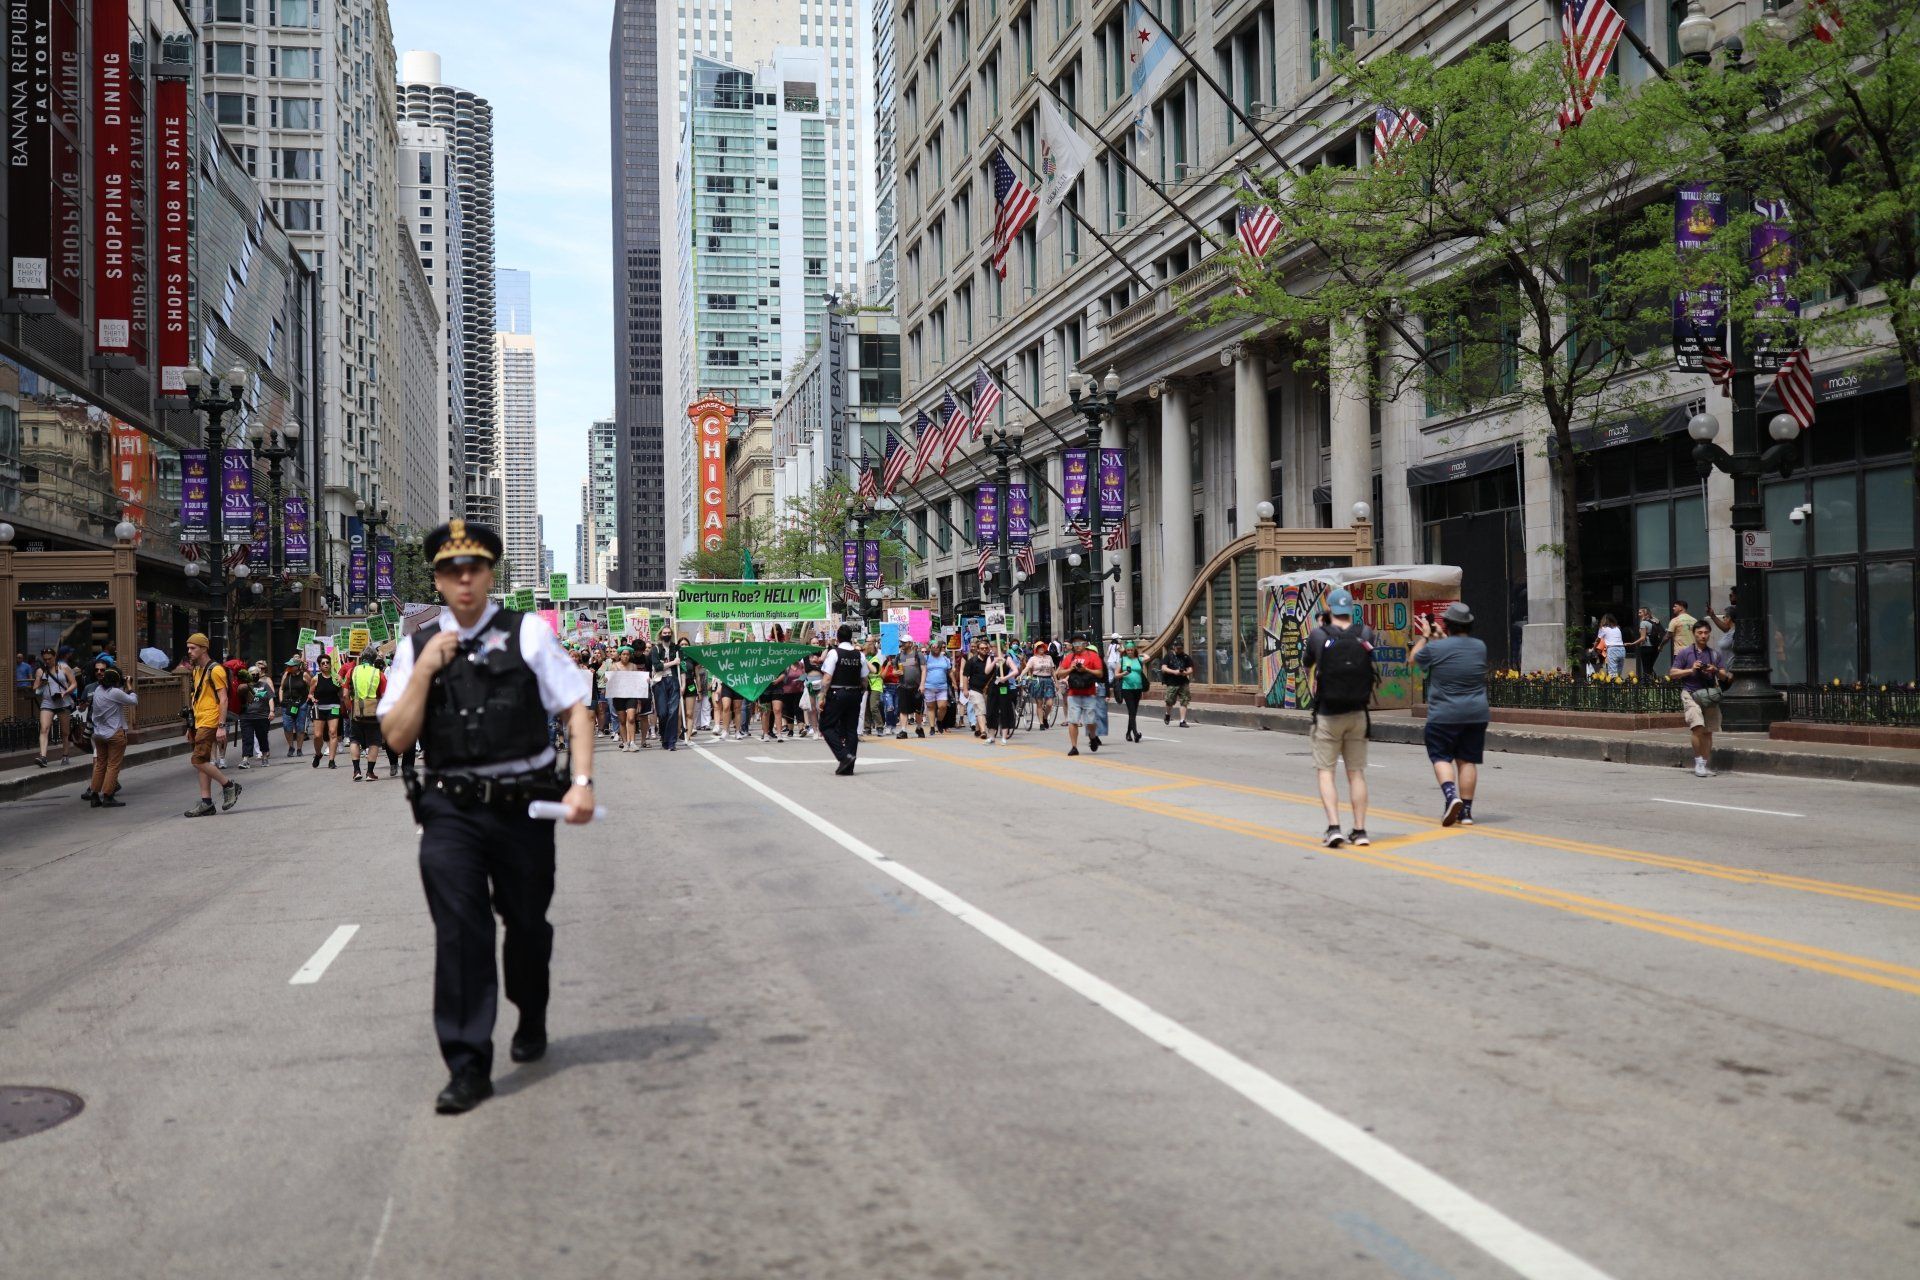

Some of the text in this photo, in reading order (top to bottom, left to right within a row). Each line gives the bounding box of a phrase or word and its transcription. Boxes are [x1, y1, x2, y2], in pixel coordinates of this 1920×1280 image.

[35, 20, 47, 123] FACTORY
[103, 53, 121, 125] DINING
[11, 80, 28, 167] BANANA
[105, 174, 122, 279] SHOPPING
[165, 117, 182, 332] SHOPS AT 108 N STATE
[17, 262, 42, 270] BLOCK
[17, 269, 42, 277] THIRTY
[17, 276, 41, 284] SEVEN
[103, 323, 126, 331] BLOCK
[103, 330, 126, 338] THIRTY
[829, 316, 841, 397] BALLET
[696, 402, 719, 412] CHASE
[678, 588, 822, 604] Overturn Roe? HELL NO!
[1376, 582, 1409, 600] CAN
[706, 610, 800, 620] Rise Up 4 Abortion Rights.org
[1352, 602, 1407, 631] BUILD
[702, 648, 718, 658] We
[721, 647, 741, 657] will
[745, 647, 763, 657] not
[717, 656, 785, 672] We will shut
[840, 657, 860, 666] POLICE
